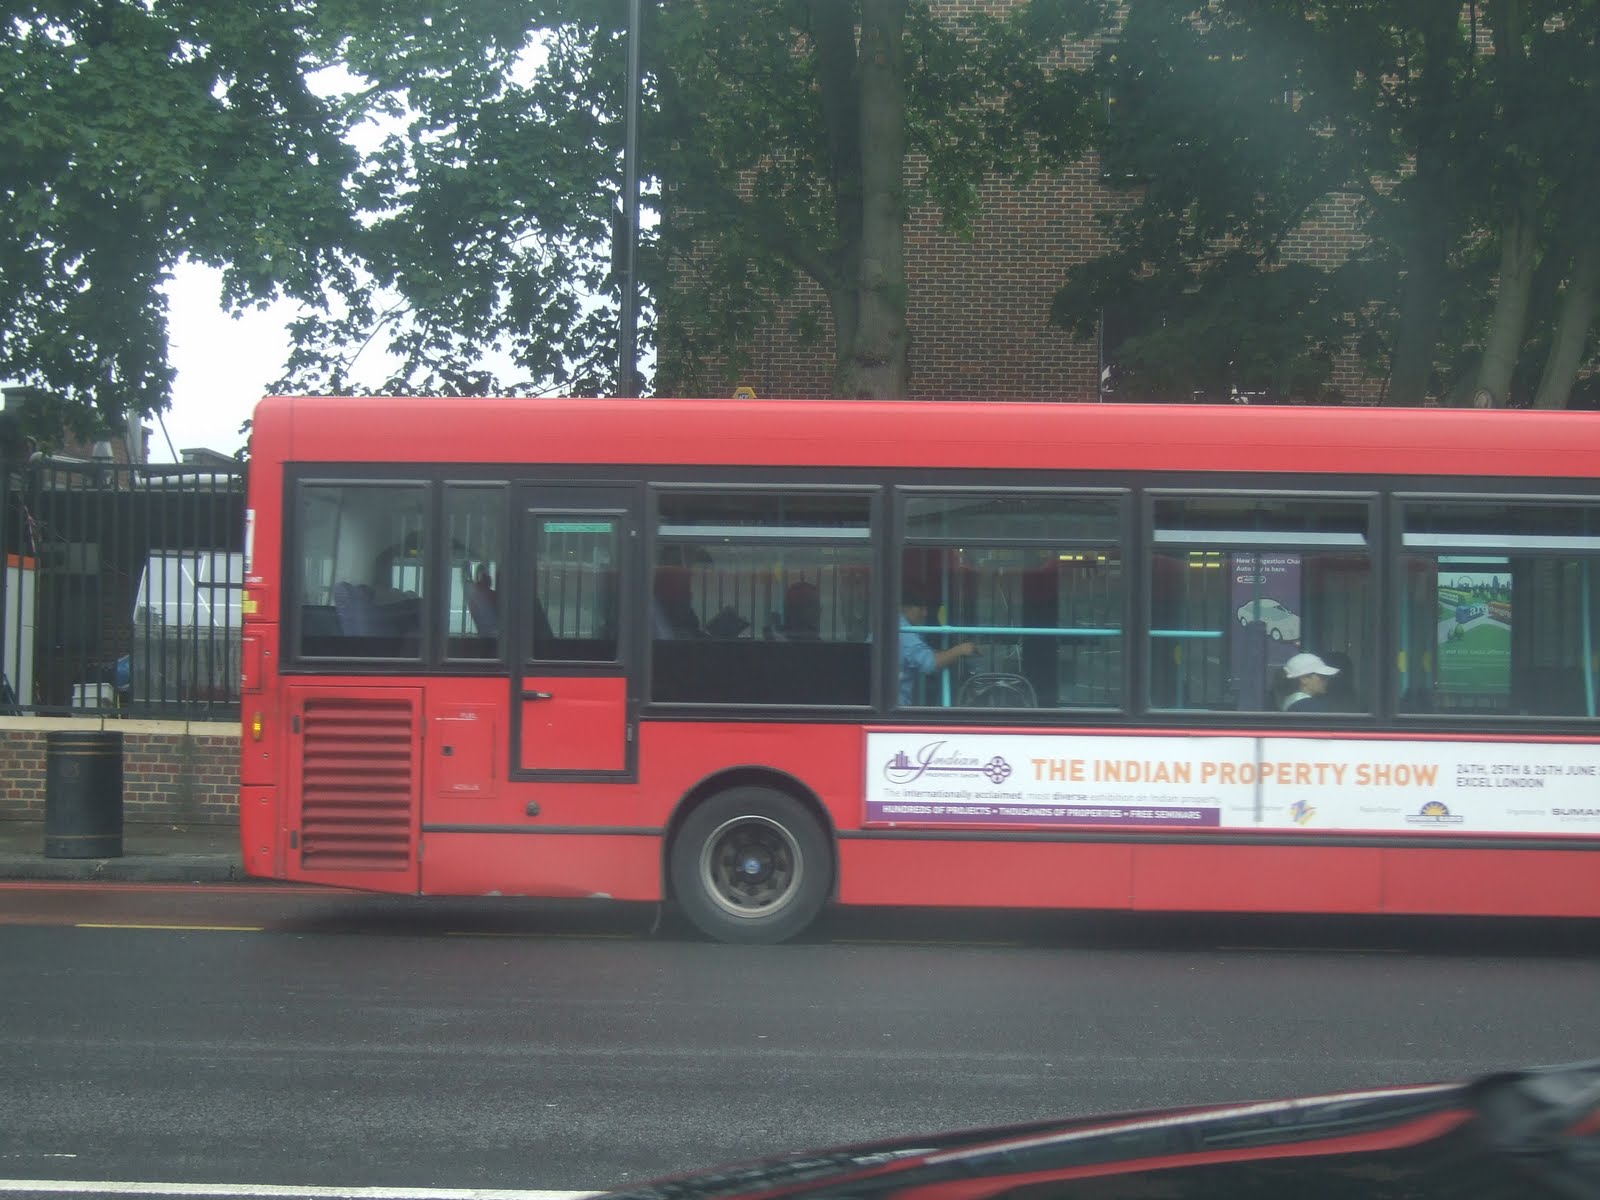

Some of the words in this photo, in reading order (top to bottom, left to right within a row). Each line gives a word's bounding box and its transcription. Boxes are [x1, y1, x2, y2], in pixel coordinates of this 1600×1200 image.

[1031, 758, 1086, 782] THE
[1094, 759, 1192, 783] INDIAN
[1200, 761, 1348, 785] PROPERTY
[1355, 763, 1439, 786] SHOW
[1565, 765, 1597, 776] JUNE
[1456, 776, 1493, 788] EXCEL
[1495, 777, 1544, 788] LONDON
[882, 804, 932, 815] HUNDREDS
[933, 805, 946, 815] OF
[946, 806, 992, 816] PROJECTS
[999, 807, 1053, 817] THOUSANDS
[1053, 808, 1067, 817] OF
[1067, 809, 1122, 818] PROPERTIES
[1129, 809, 1154, 818] FREE
